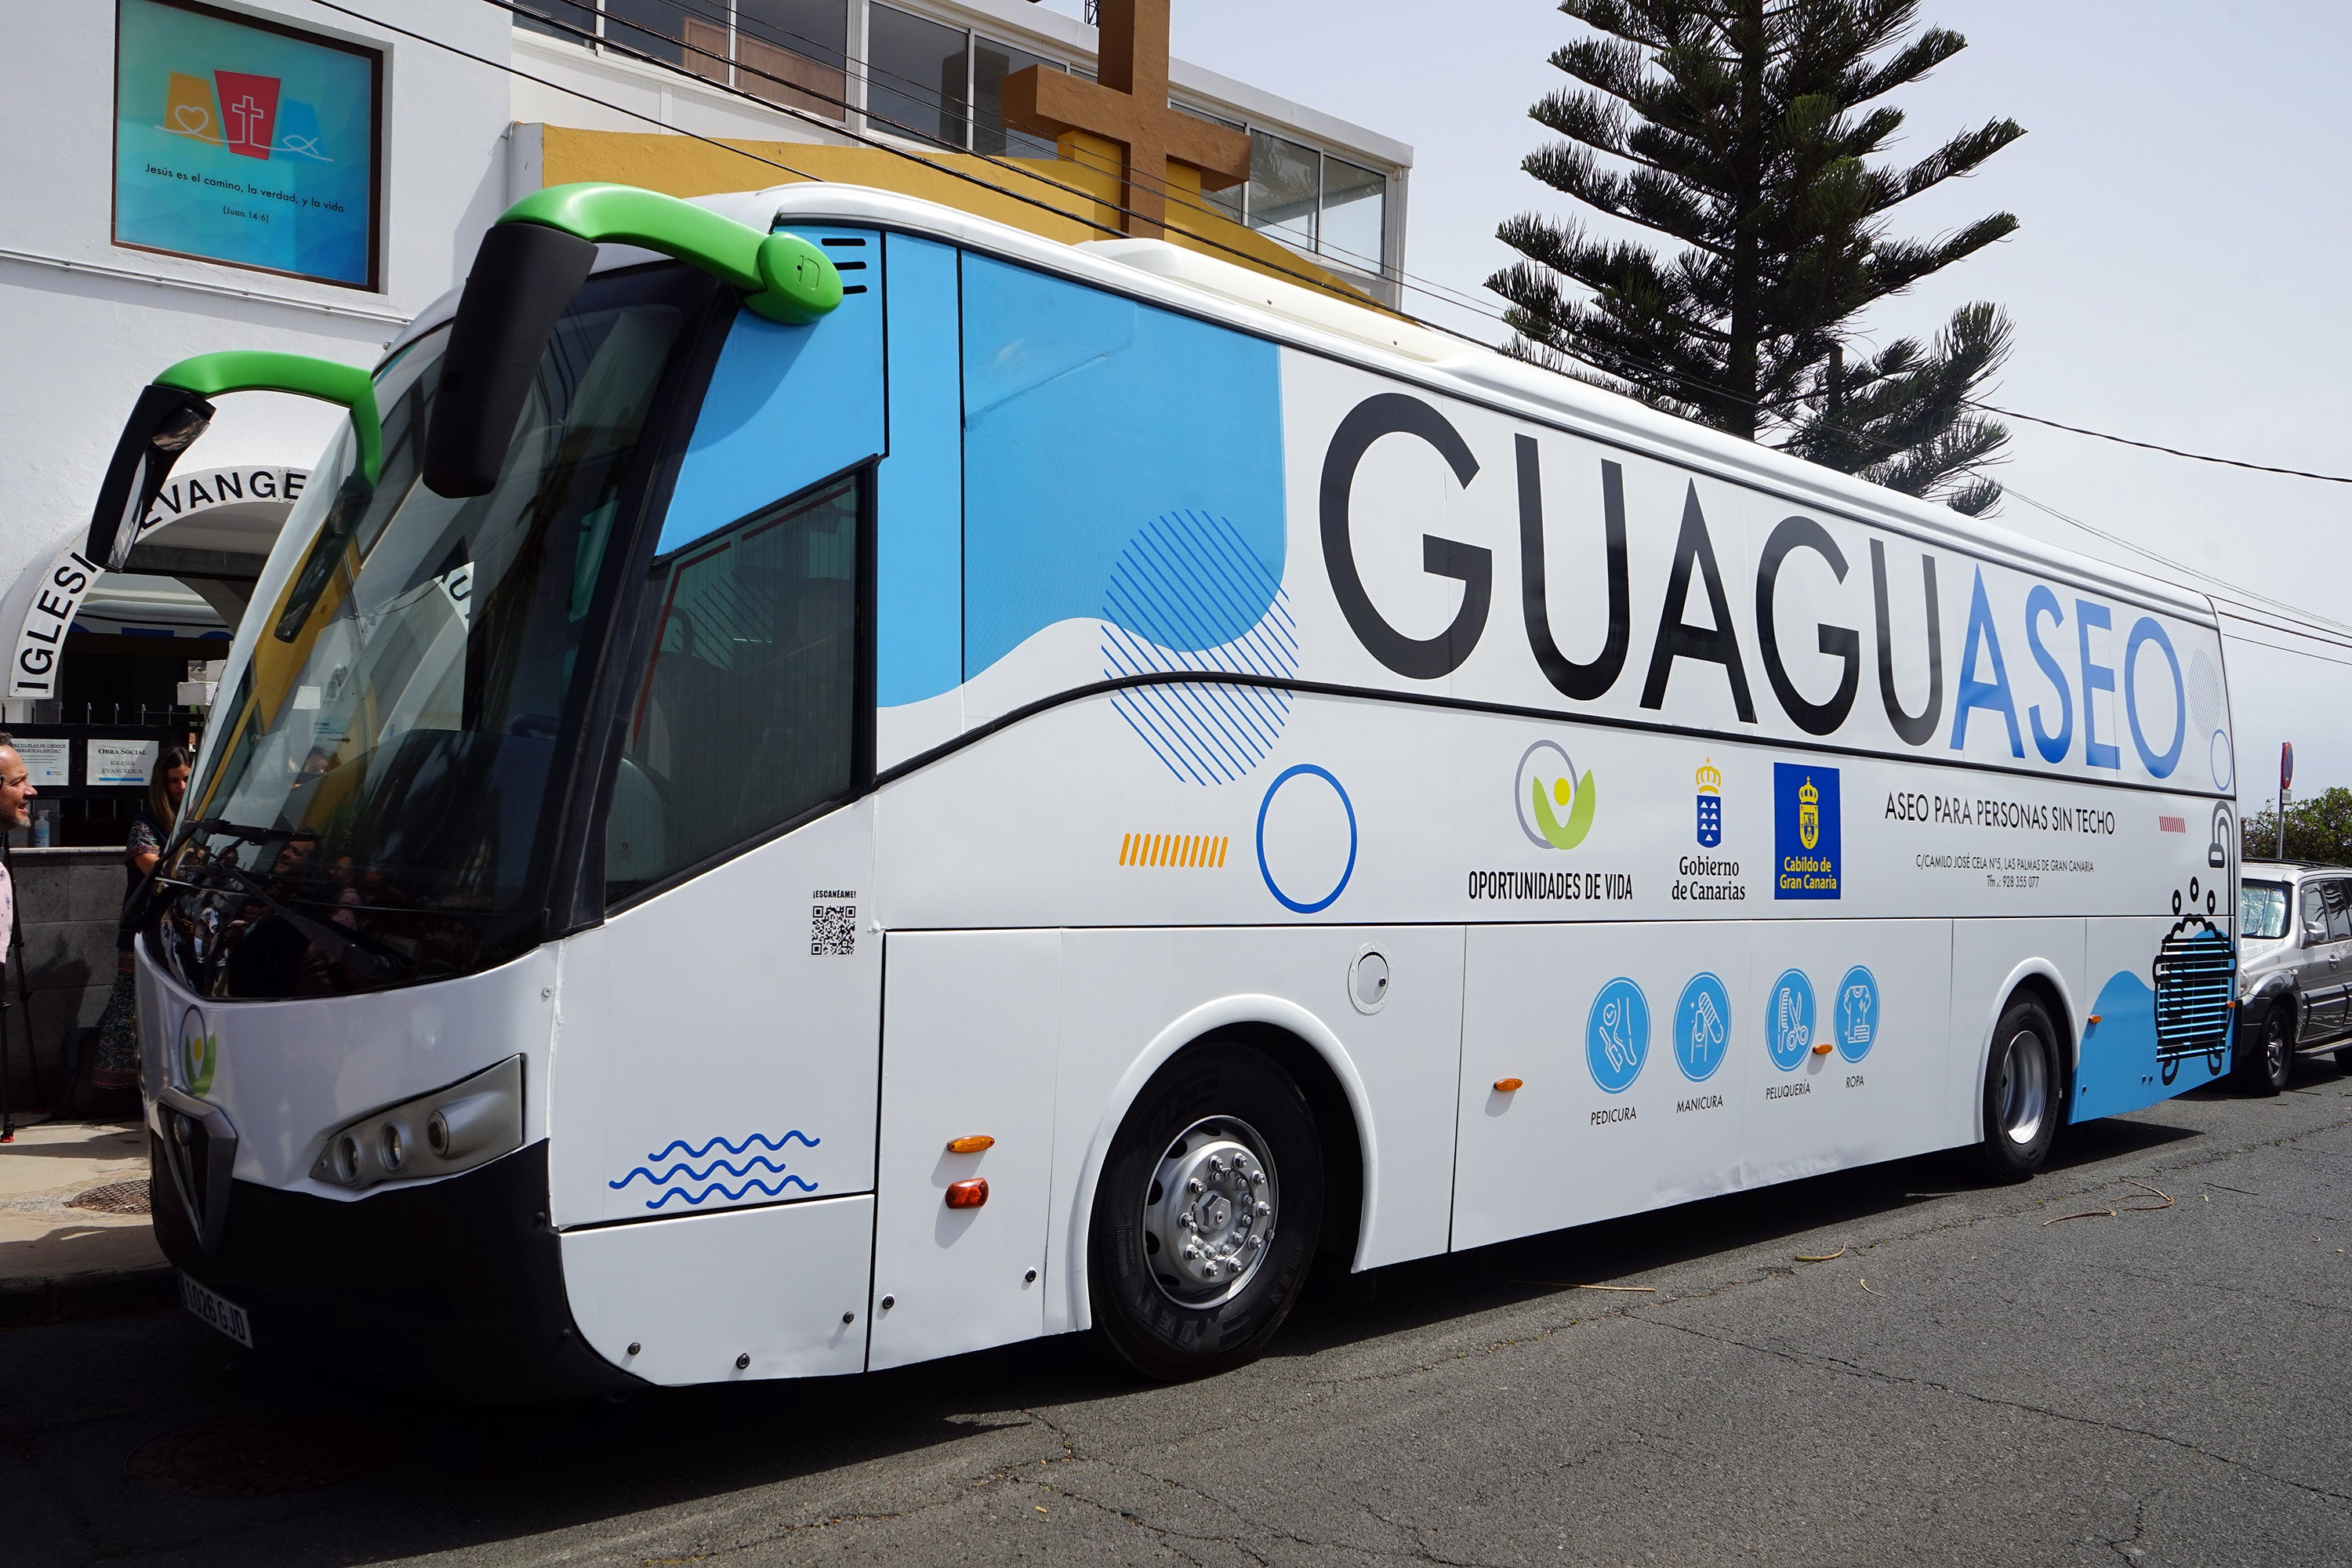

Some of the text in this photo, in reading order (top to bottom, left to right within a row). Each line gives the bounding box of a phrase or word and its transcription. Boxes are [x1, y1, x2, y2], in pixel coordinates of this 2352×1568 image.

[144, 163, 344, 212] Jesús es el camino, la verdad, y la vida
[223, 205, 270, 223] (Juan 14:6)
[16, 470, 307, 689] IGLESI EVANGE
[1319, 392, 2186, 779] GUAGUASEO
[1885, 791, 2115, 835] ASEO PARA PERSONAS SIN TECHO
[1679, 855, 1740, 877] Gobierno
[1783, 855, 1831, 873] Cabildo de
[1915, 854, 1952, 870] C/CAMILO
[1954, 852, 1970, 869] JOSÉ
[1972, 856, 1987, 869] CELA
[2005, 858, 2016, 870] LAS
[2017, 858, 2040, 871] PALMAS
[2042, 859, 2049, 871] DE
[2050, 859, 2067, 871] GRAN
[2069, 860, 2094, 872] CANARIA
[1468, 870, 1633, 900] OPORTUNIDADES DE VIDA
[1671, 880, 1746, 901] de Canarias
[1779, 873, 1837, 890] Gran Canaria
[2002, 875, 2014, 887] 928
[2016, 876, 2027, 887] 355
[2028, 876, 2039, 887] 077
[812, 889, 856, 899] ¡ESCANÉAME!
[1766, 1079, 1810, 1100] PELUQUERÍA
[1846, 1075, 1864, 1089] ROPA
[1676, 1094, 1723, 1113] MANICURA
[1591, 1106, 1637, 1126] PEDICURA
[186, 1279, 246, 1341] 1026 GJD
